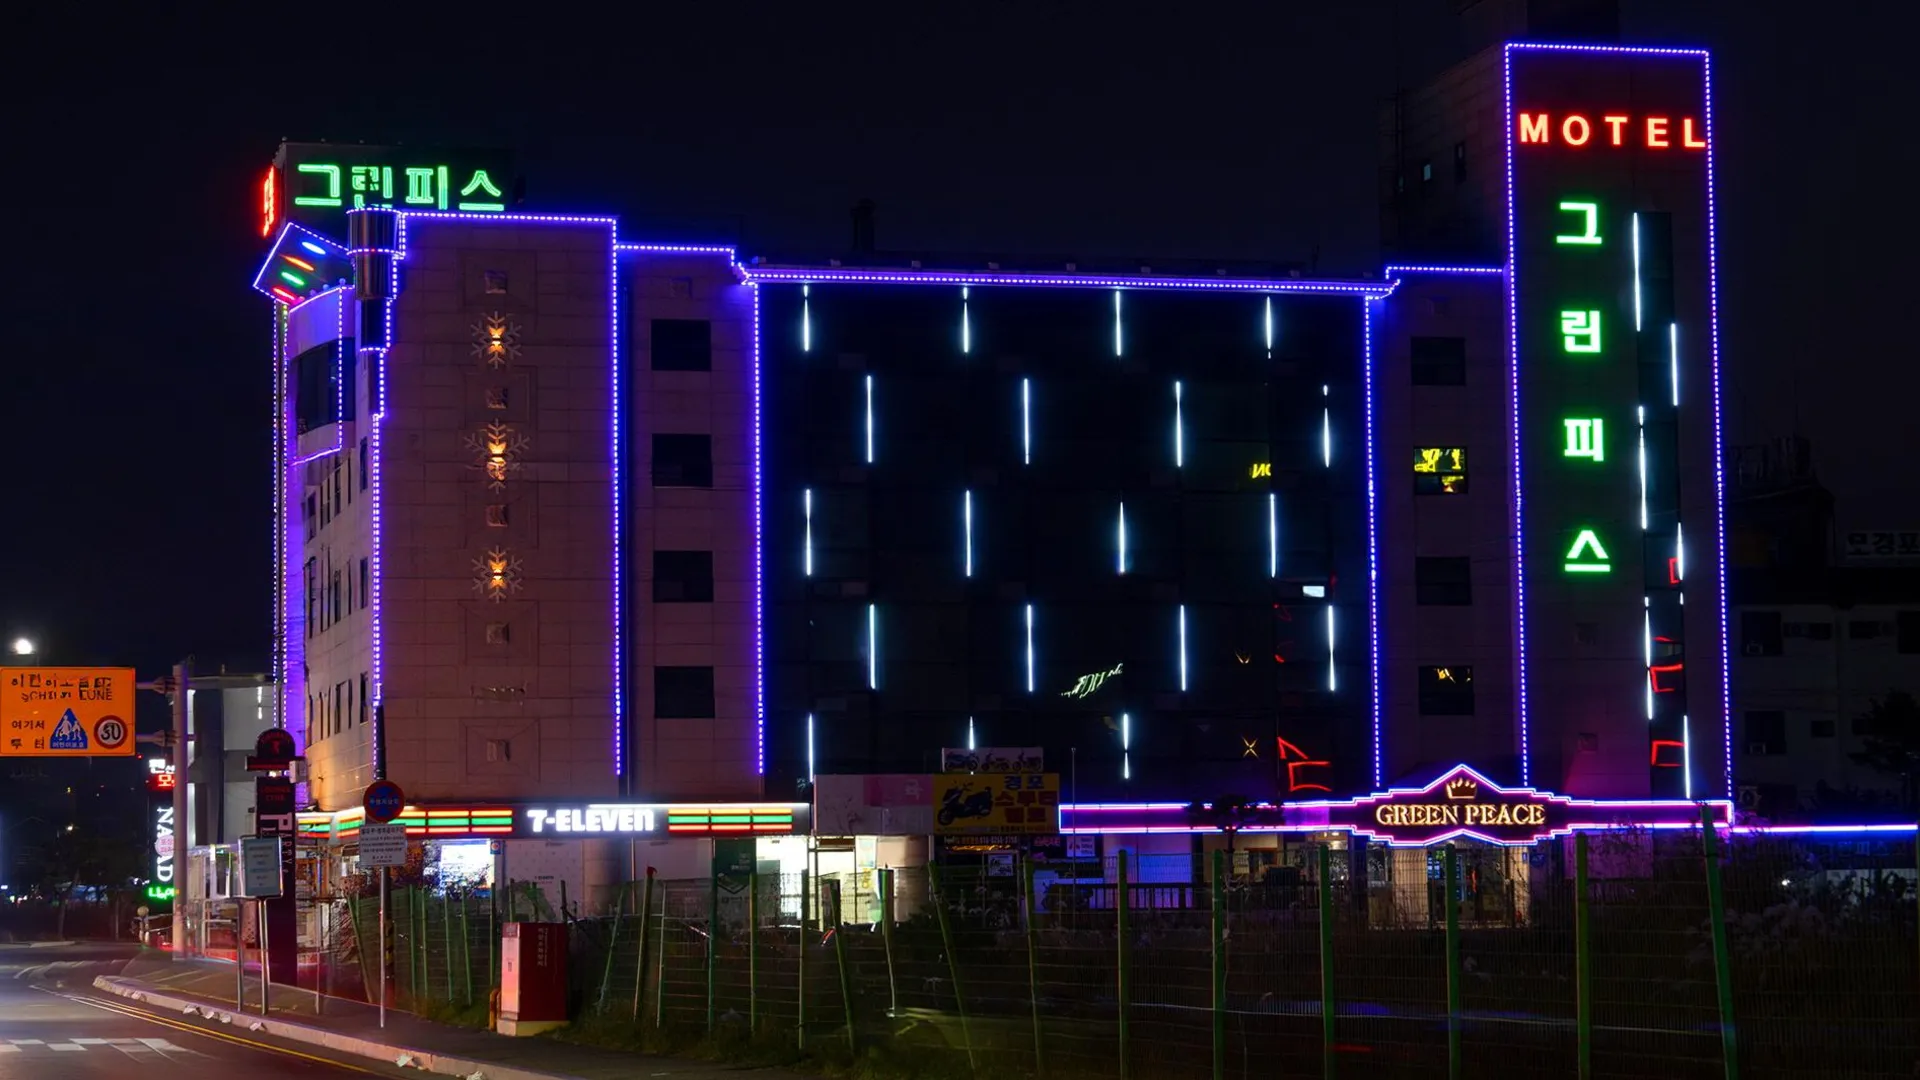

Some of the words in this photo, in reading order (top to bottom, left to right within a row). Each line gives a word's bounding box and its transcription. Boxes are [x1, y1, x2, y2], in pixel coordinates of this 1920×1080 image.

[1519, 113, 1706, 148] MOTEL
[294, 163, 505, 212] 그린피스
[1556, 201, 1611, 573] 그린피스
[1375, 803, 1459, 826] GREEN
[1464, 803, 1546, 826] PEACE
